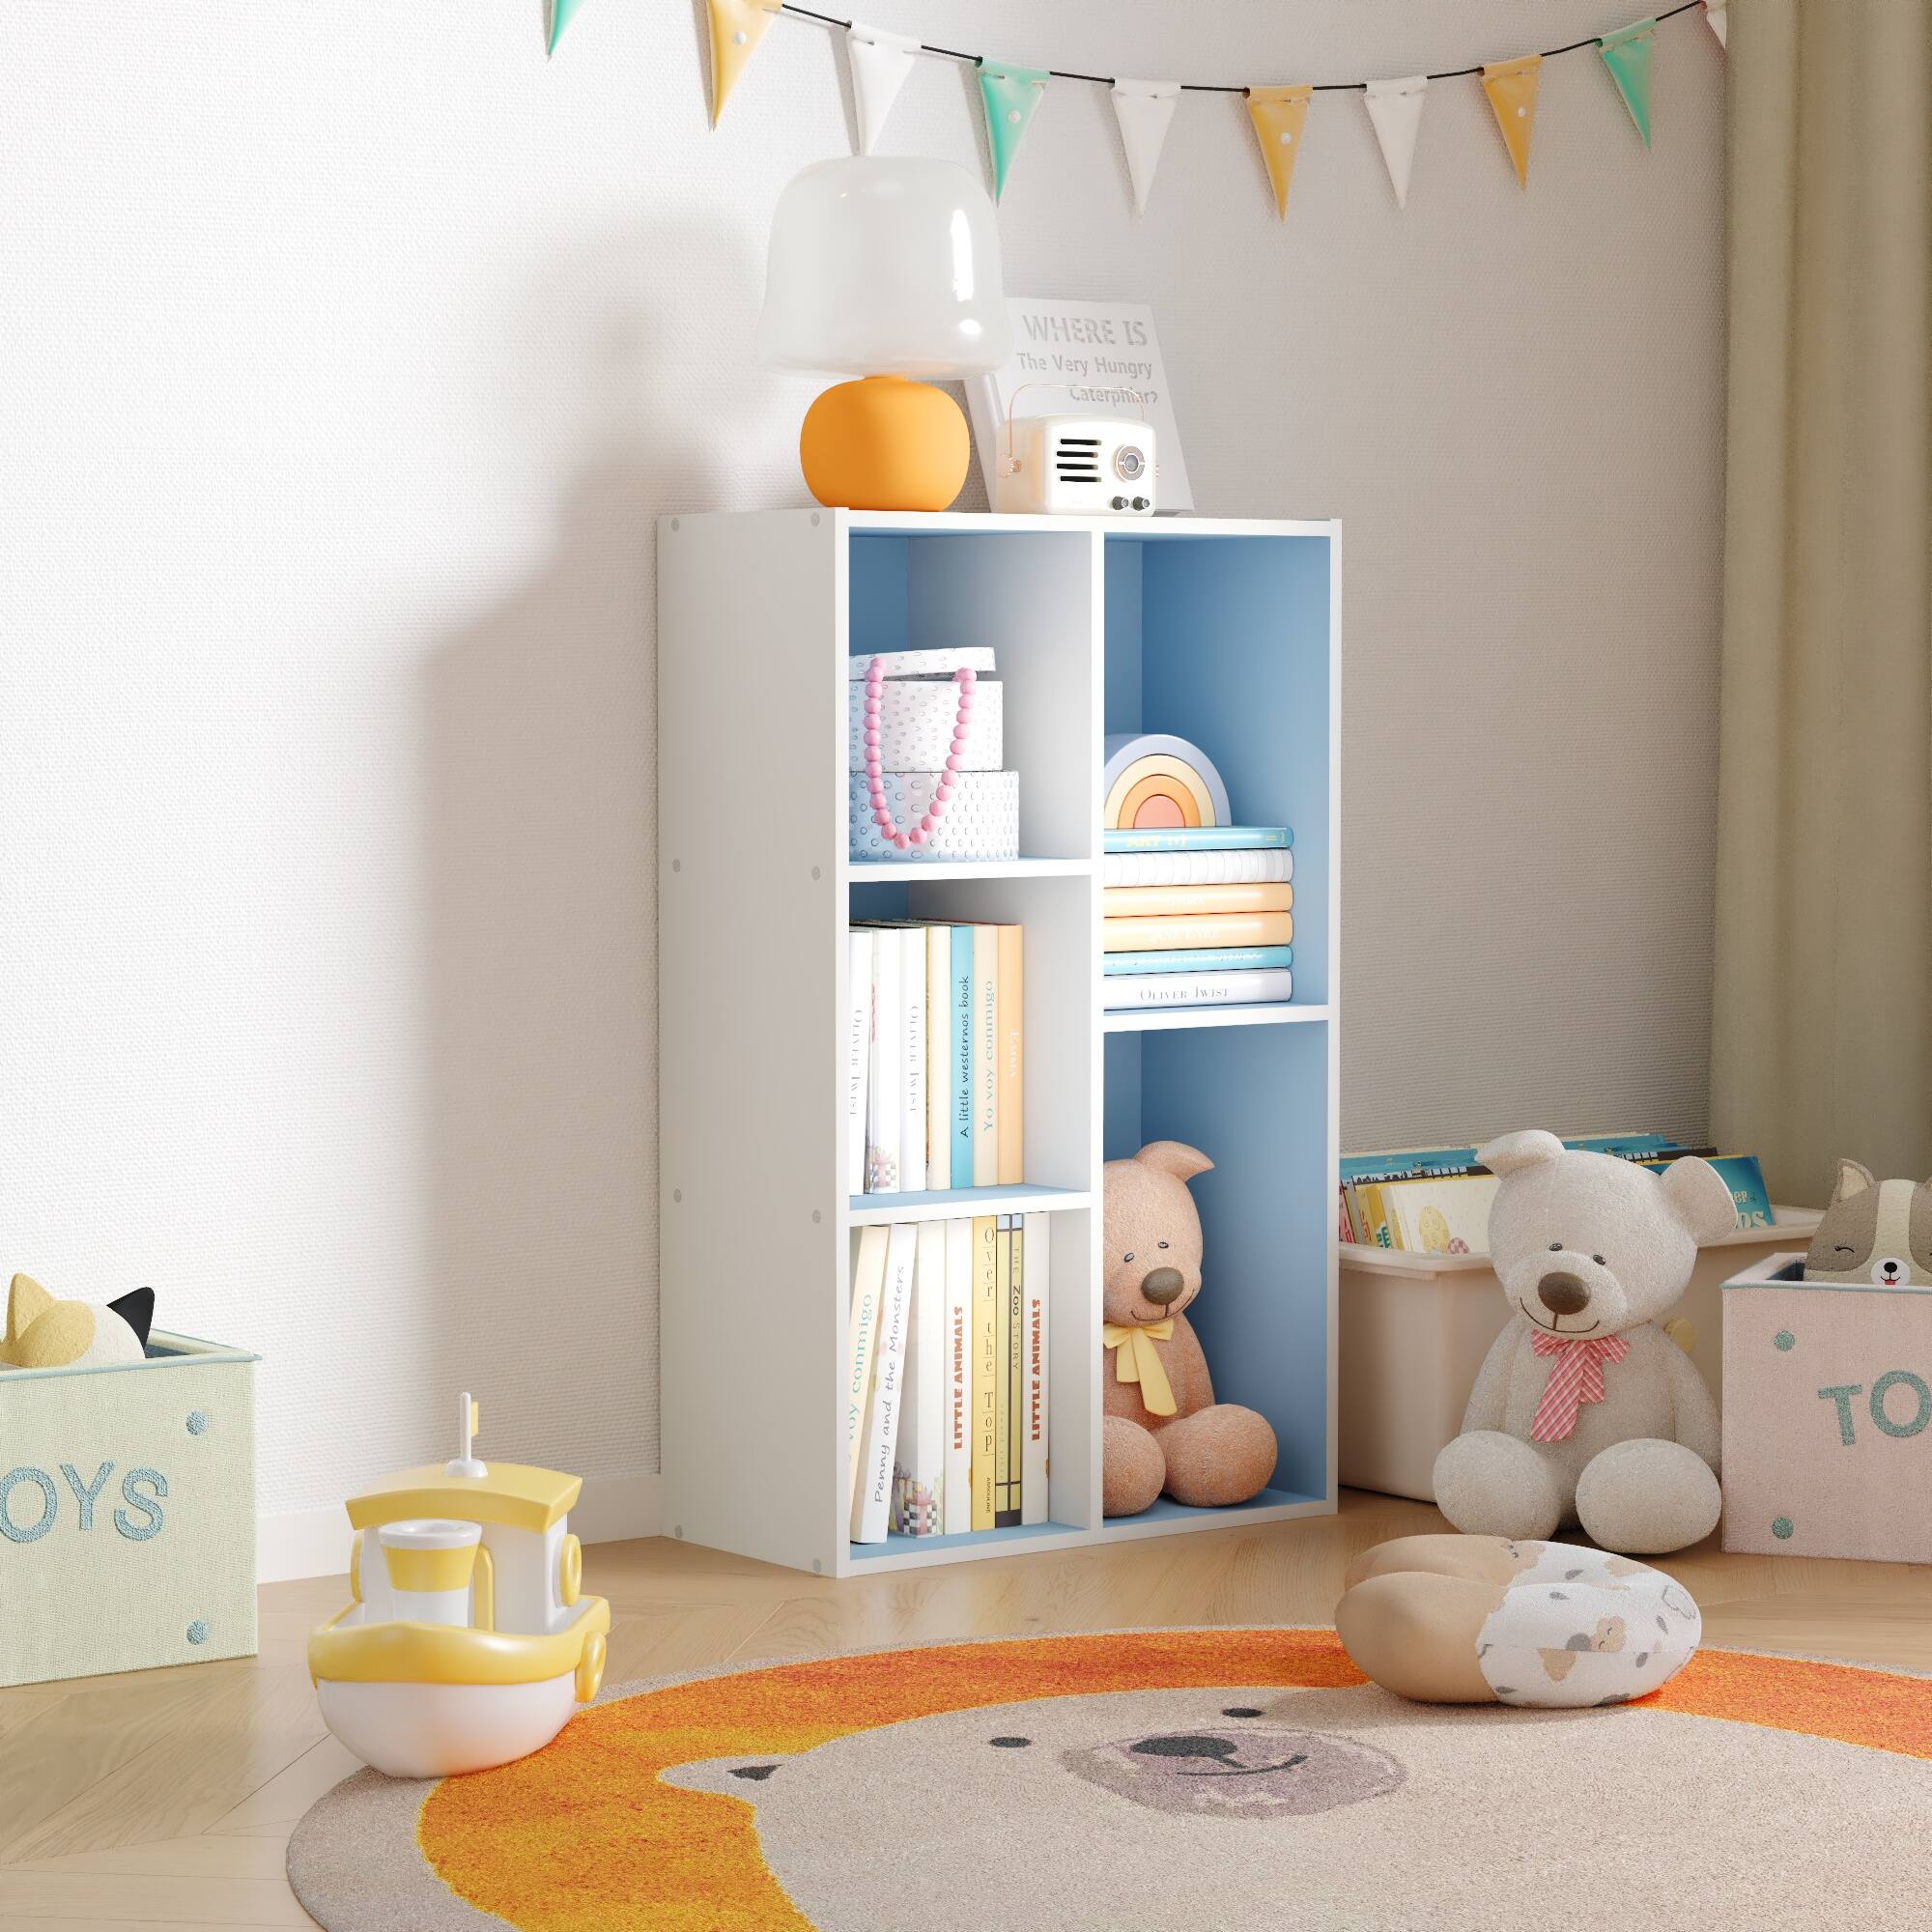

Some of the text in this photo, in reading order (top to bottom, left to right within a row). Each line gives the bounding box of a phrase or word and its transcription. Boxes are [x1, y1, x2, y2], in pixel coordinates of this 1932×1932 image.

[1021, 315, 1149, 347] WHERE IS
[1016, 353, 1152, 380] The Very Hungry
[958, 975, 969, 1008] book
[983, 980, 996, 1132] Yo voy conmigo
[958, 1090, 969, 1122] little
[959, 1125, 969, 1138] A
[852, 1293, 873, 1394] conmigo
[1031, 1298, 1041, 1441] LITTLE ANIMALS
[874, 1265, 905, 1503] Penny and the Monsters
[953, 1305, 963, 1450] LITTLE ANIMALS
